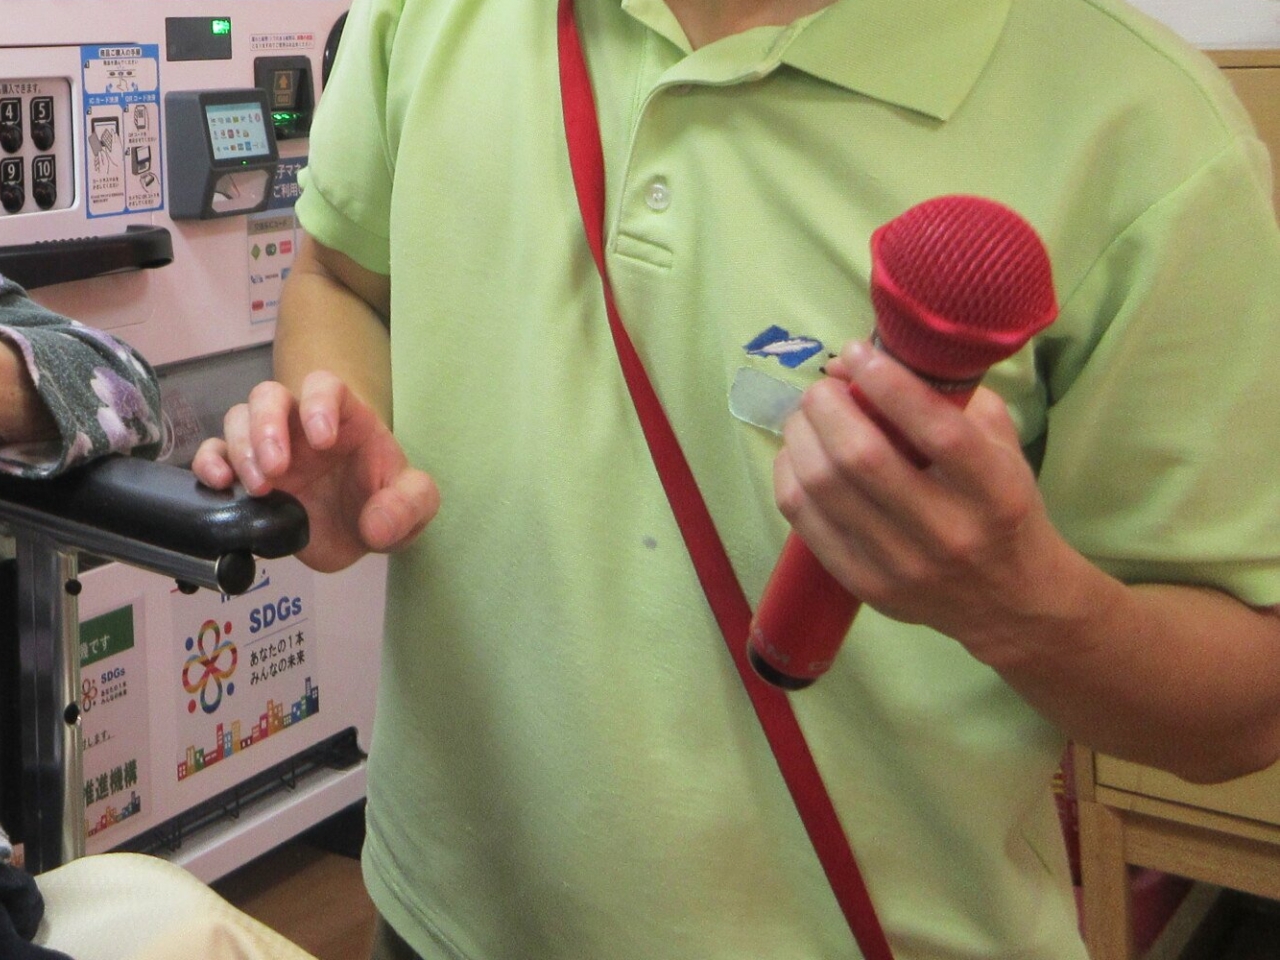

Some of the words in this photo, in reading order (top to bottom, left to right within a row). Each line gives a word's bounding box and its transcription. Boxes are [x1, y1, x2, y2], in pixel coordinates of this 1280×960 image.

[5, 104, 14, 119] 4
[38, 102, 46, 118] 5
[7, 164, 15, 179] 9
[37, 161, 50, 177] 10
[275, 163, 302, 179] 子マネ
[249, 596, 302, 634] SDGs
[250, 630, 305, 667] あなたの1本
[250, 650, 305, 685] みんなの未来
[101, 668, 125, 684] SDGs
